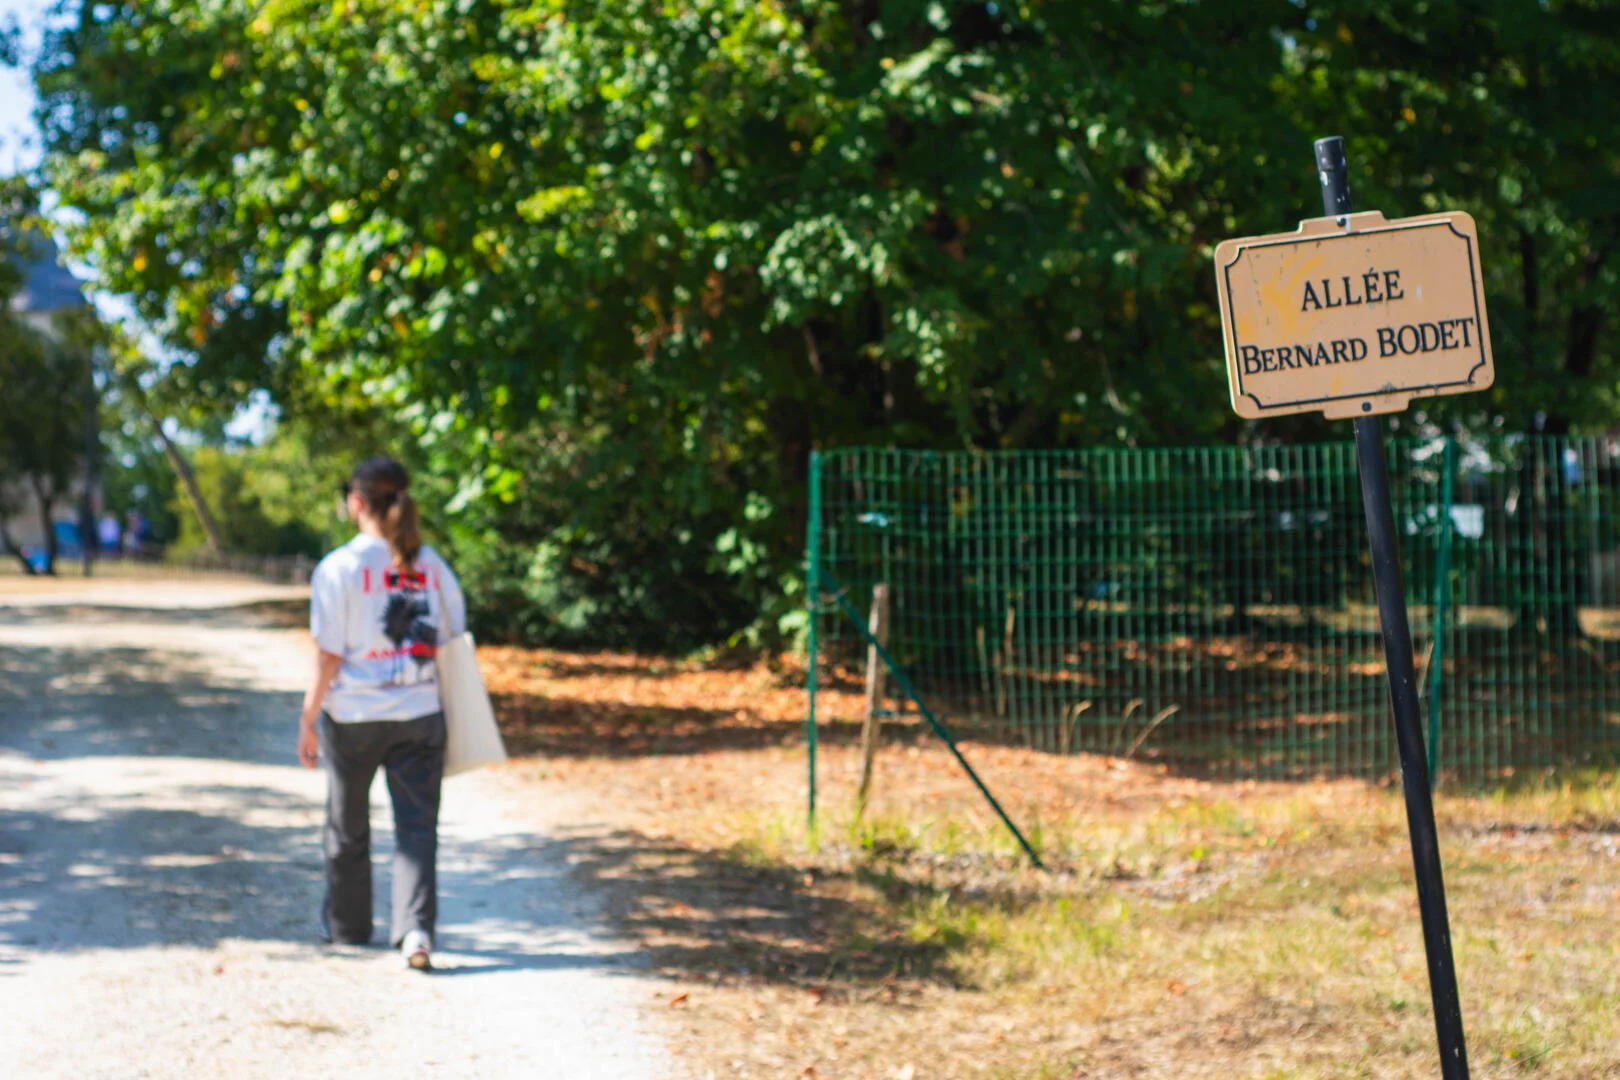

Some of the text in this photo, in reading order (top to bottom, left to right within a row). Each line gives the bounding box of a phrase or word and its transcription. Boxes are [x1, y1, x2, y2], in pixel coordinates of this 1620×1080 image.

[1301, 267, 1404, 312] ALLÉE
[1240, 317, 1474, 375] BERNARD BODET
